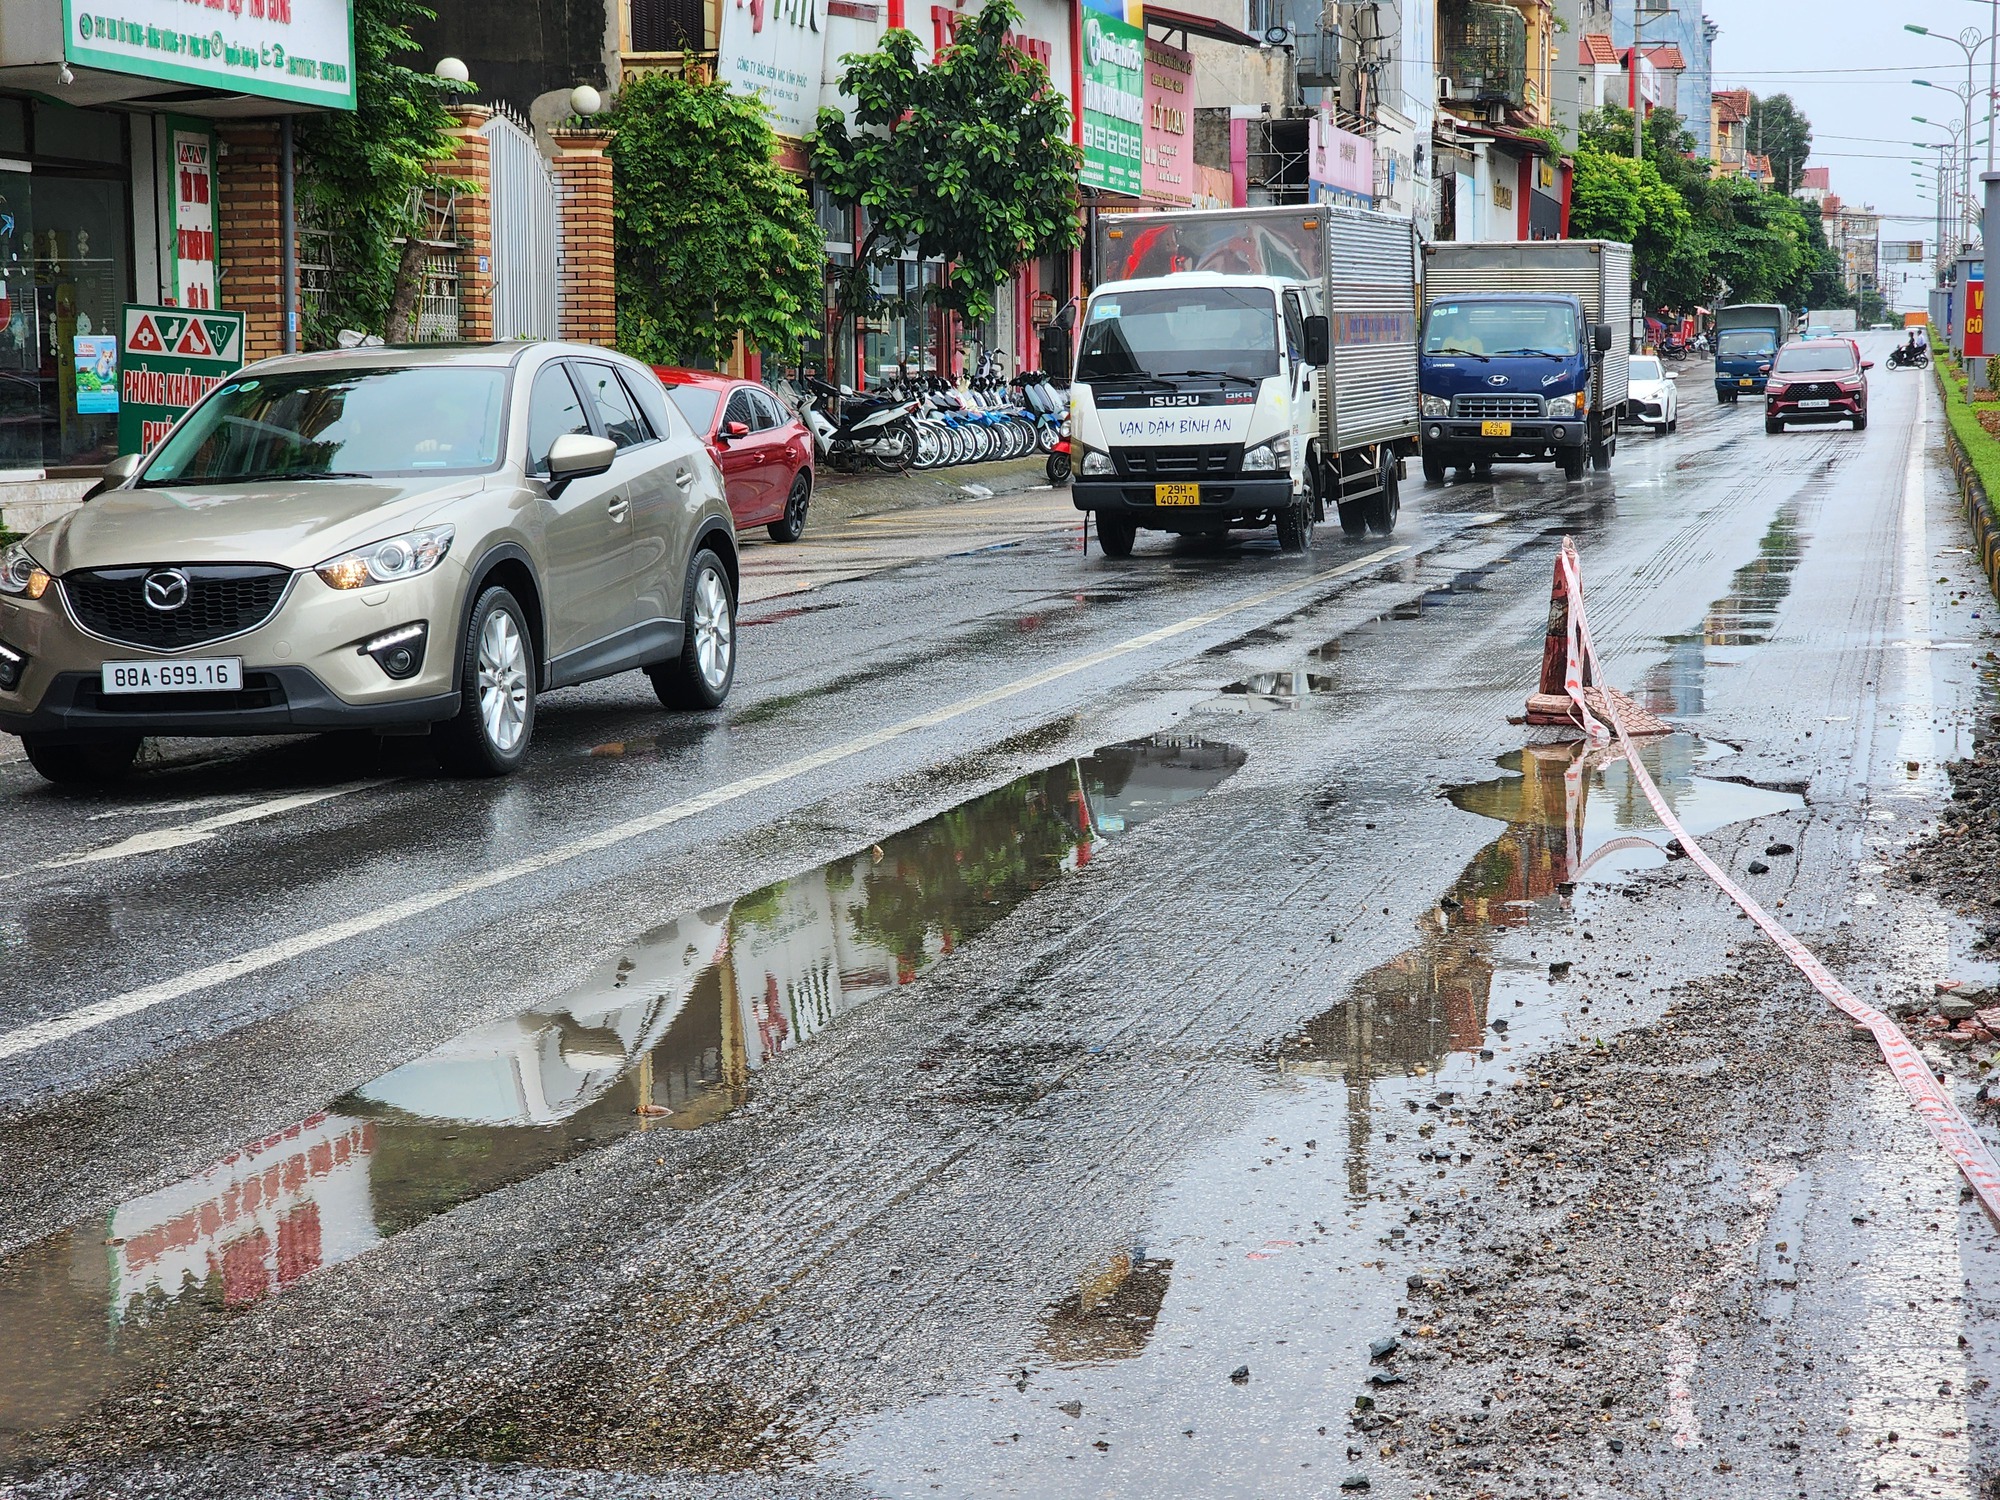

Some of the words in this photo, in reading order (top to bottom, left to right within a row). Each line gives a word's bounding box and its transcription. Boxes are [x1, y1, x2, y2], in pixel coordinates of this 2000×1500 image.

[1164, 108, 1187, 136] LOAN
[1967, 315, 1984, 333] CÔ
[123, 363, 165, 405] PHÒNG
[166, 367, 203, 408] KHÁM
[1149, 395, 1199, 407] ISUZU
[1119, 421, 1143, 438] VẠN
[1148, 417, 1175, 437] DẶM
[1180, 416, 1210, 434] BÌNH
[1213, 418, 1232, 432] AN
[1168, 485, 1187, 495] 29H
[1161, 496, 1195, 505] 402.70
[116, 665, 228, 686] 88A-699.16
